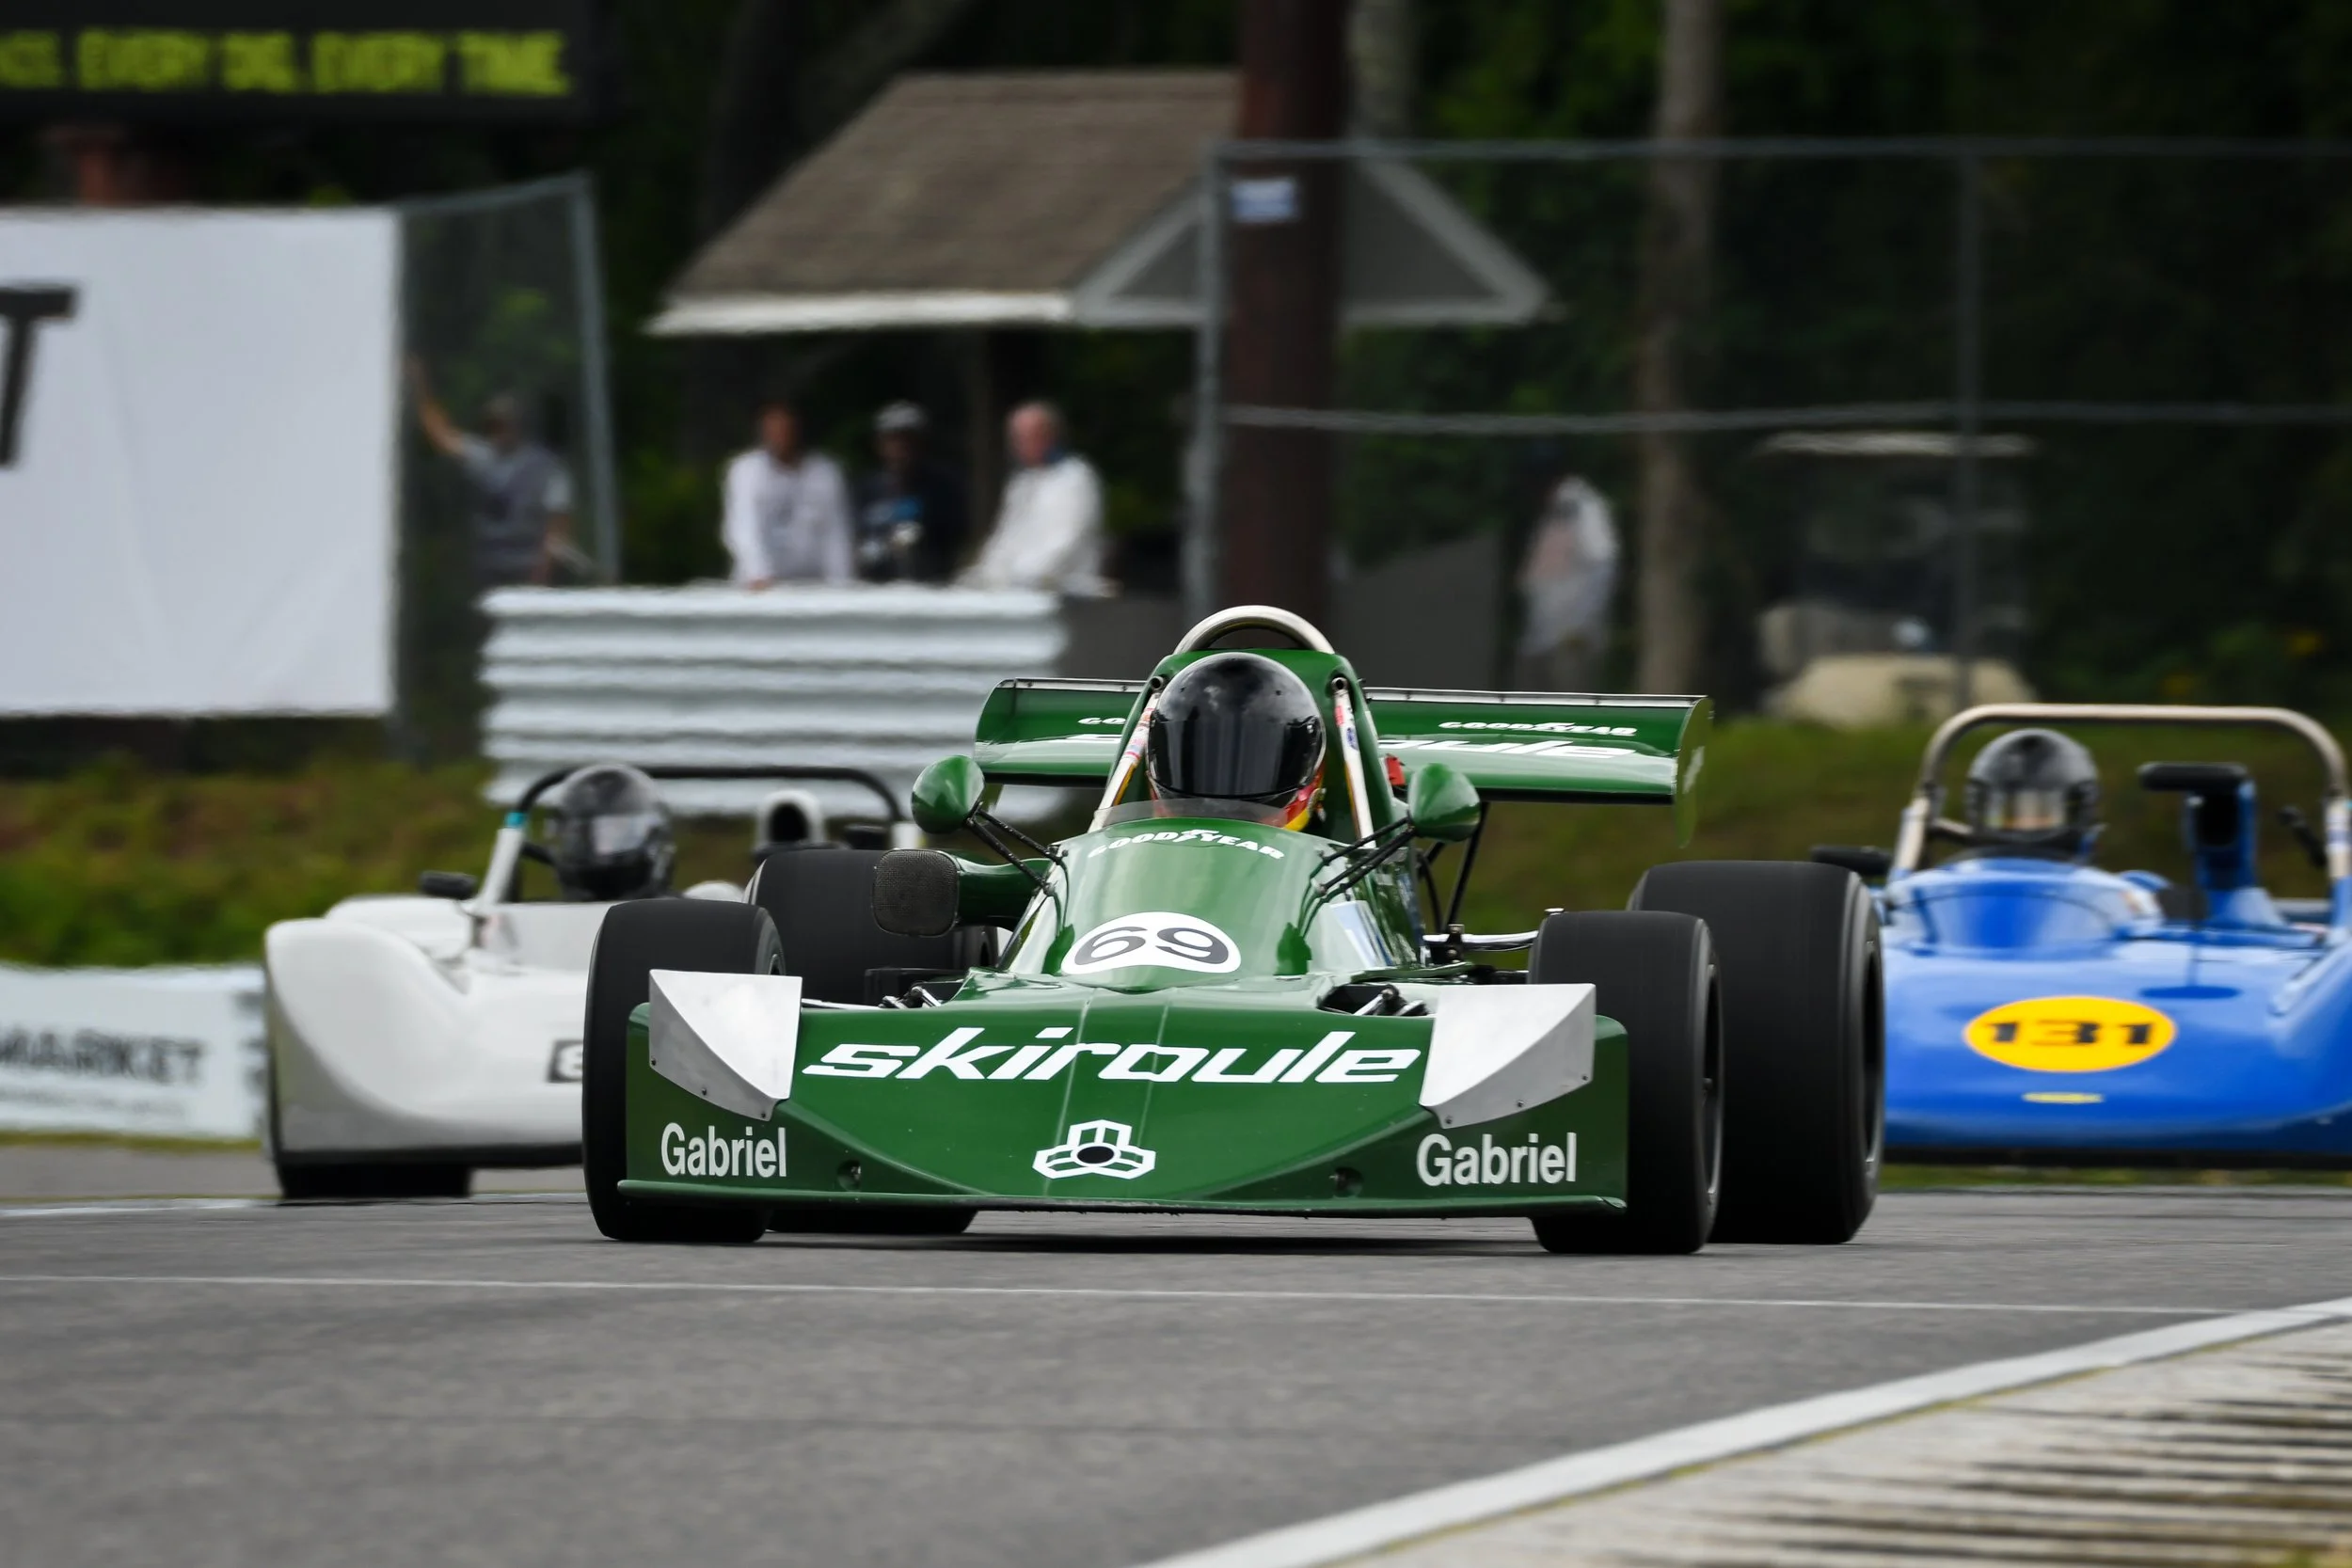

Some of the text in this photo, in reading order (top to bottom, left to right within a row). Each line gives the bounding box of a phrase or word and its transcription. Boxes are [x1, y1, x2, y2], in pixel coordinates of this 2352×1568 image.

[1438, 721, 1637, 736] GOODYEAR
[1088, 829, 1284, 859] GOODYEAR
[1074, 926, 1229, 965] 69
[1985, 1020, 2153, 1045] 131
[802, 1027, 1421, 1083] skiroule
[660, 1122, 787, 1178] Gabriel
[1417, 1132, 1577, 1187] Gabriel
